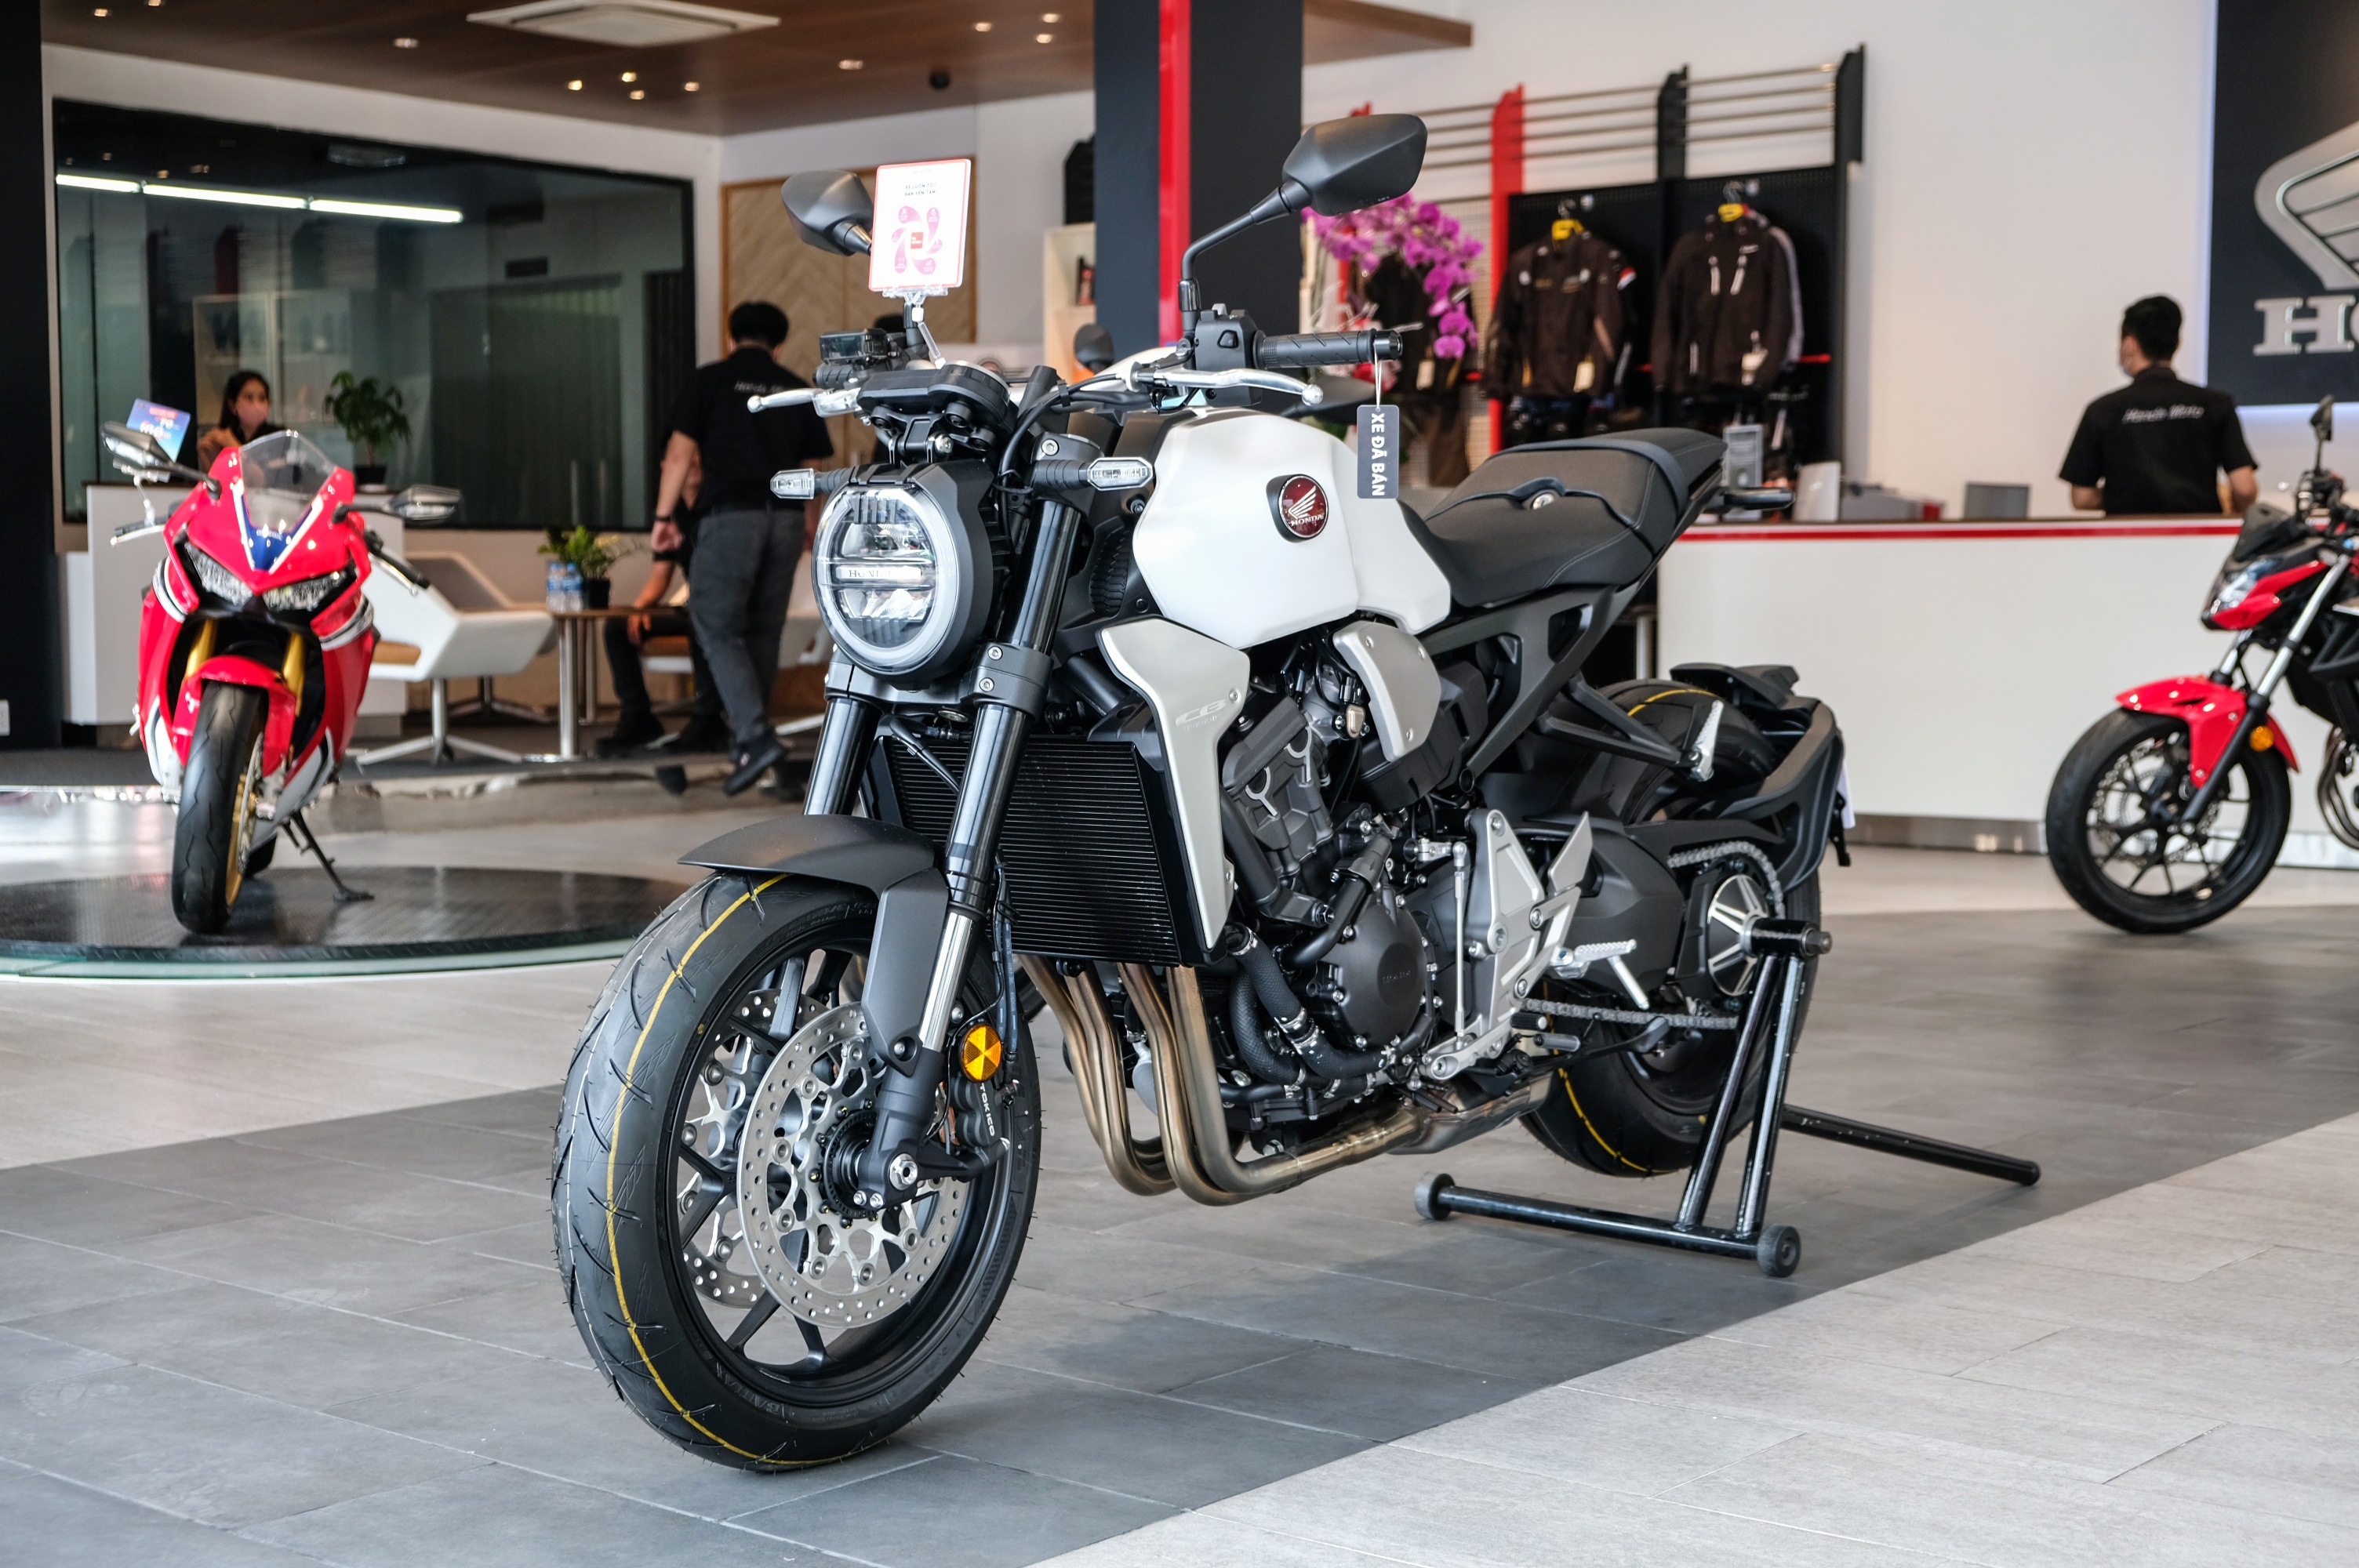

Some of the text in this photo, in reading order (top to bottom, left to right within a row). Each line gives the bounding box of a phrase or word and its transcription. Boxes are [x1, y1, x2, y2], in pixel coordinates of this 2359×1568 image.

[2252, 295, 2359, 356] H
[1371, 413, 1387, 496] XE ĐÃ BÁN
[1290, 514, 1324, 526] HONDA
[849, 569, 892, 578] HON
[1175, 699, 1226, 726] CB
[980, 1082, 995, 1137] TOKICO
